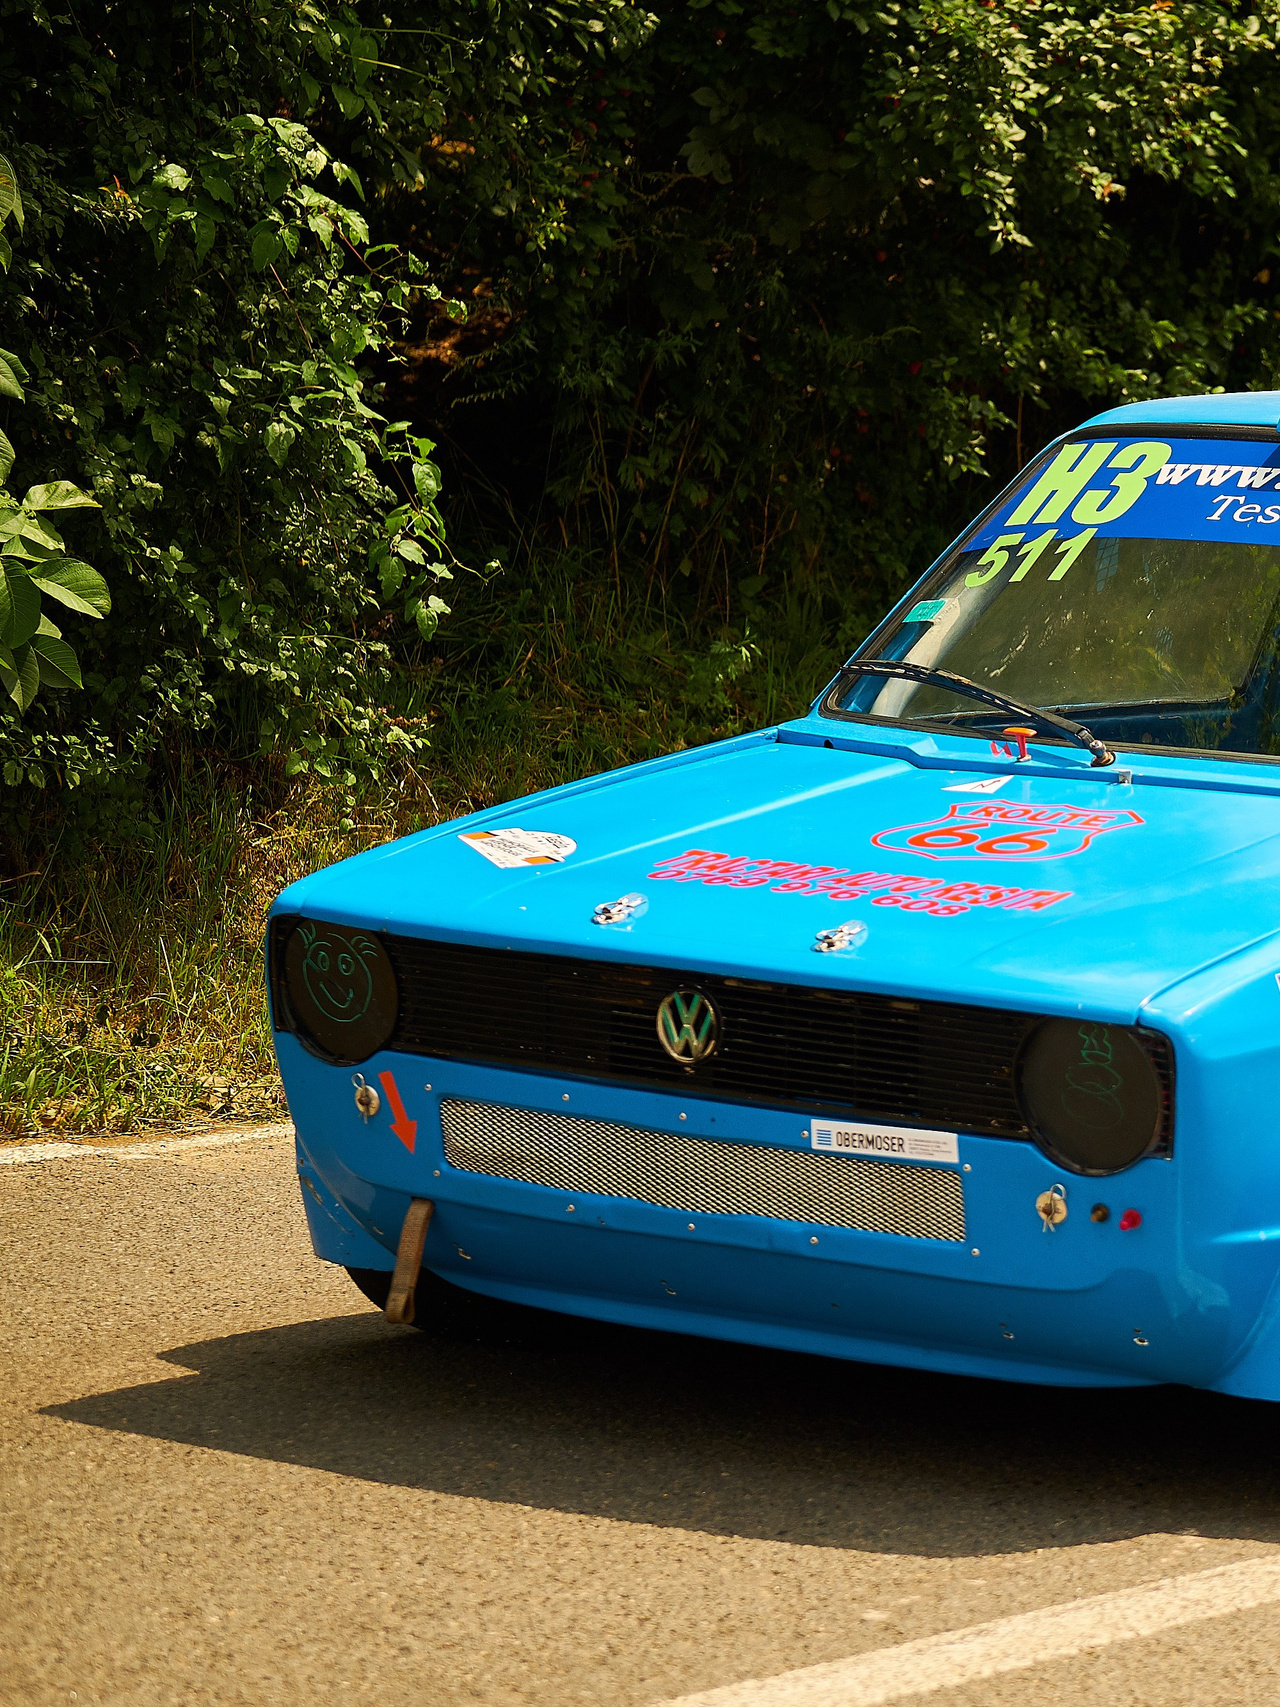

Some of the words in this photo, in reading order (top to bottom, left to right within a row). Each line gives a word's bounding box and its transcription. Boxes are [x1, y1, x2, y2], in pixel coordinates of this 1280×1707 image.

[1004, 441, 1173, 527] H3
[964, 527, 1090, 588] 511
[906, 821, 1059, 856] 66
[970, 804, 1117, 828] ROUTE
[647, 869, 770, 888] 0769
[770, 881, 869, 900] 976
[871, 895, 971, 916] 608
[653, 849, 850, 881] TRACTARI
[816, 871, 945, 893] AUTO
[919, 881, 1075, 912] RESITA
[835, 1131, 906, 1153] OBERMOSER
